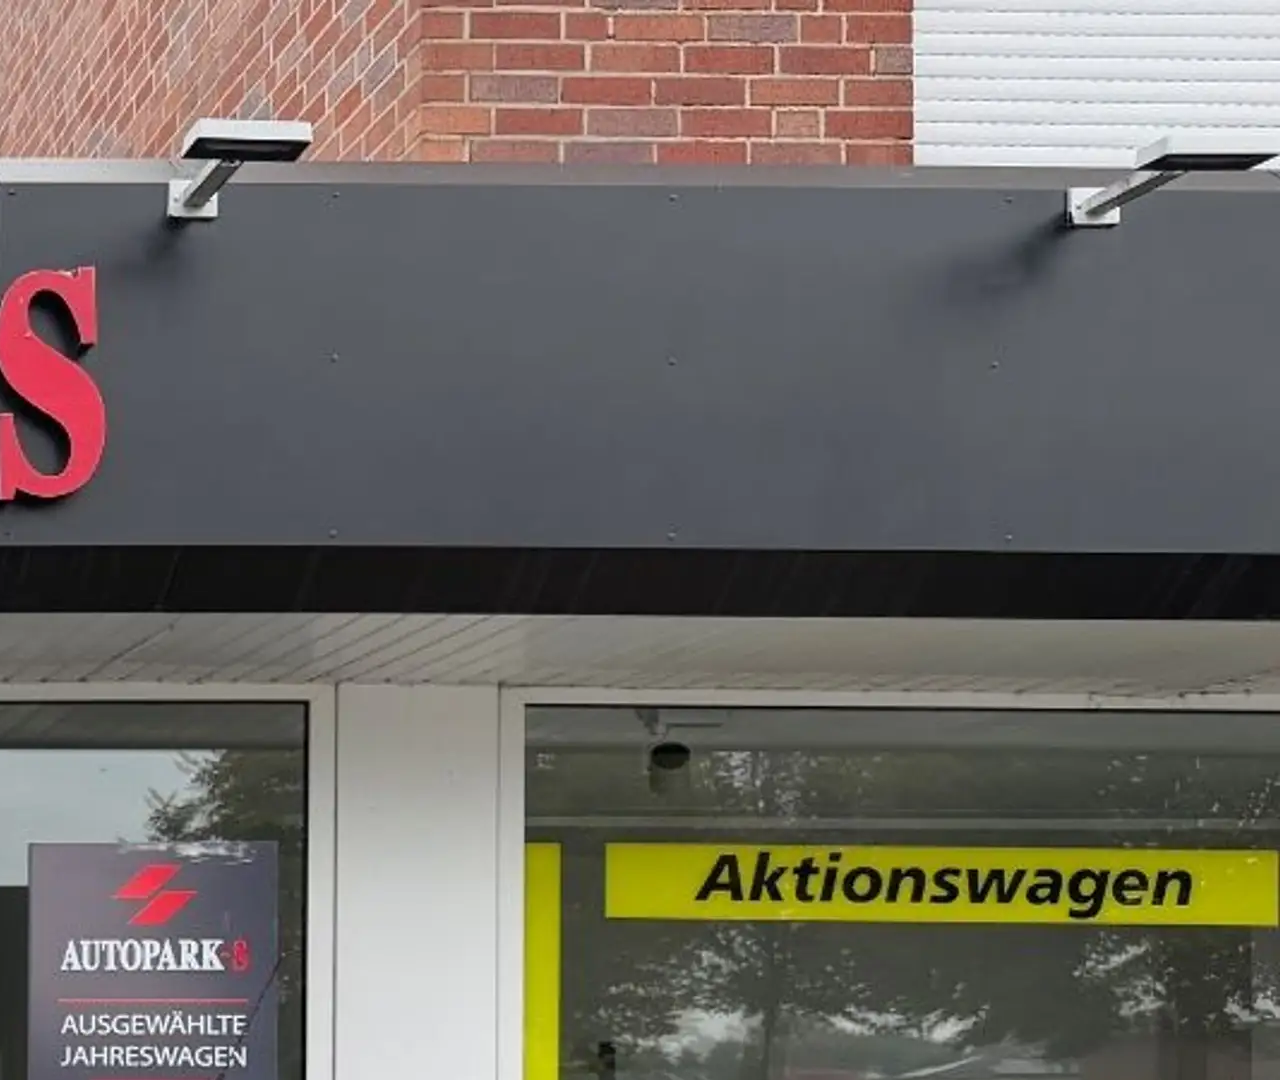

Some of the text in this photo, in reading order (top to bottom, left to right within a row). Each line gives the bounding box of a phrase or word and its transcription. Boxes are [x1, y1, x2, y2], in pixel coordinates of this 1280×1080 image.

[696, 851, 1193, 919] Aktionswagen
[59, 1010, 248, 1036] AUSGEWÄHLTE
[59, 1045, 248, 1068] JAHRESWAGEN
